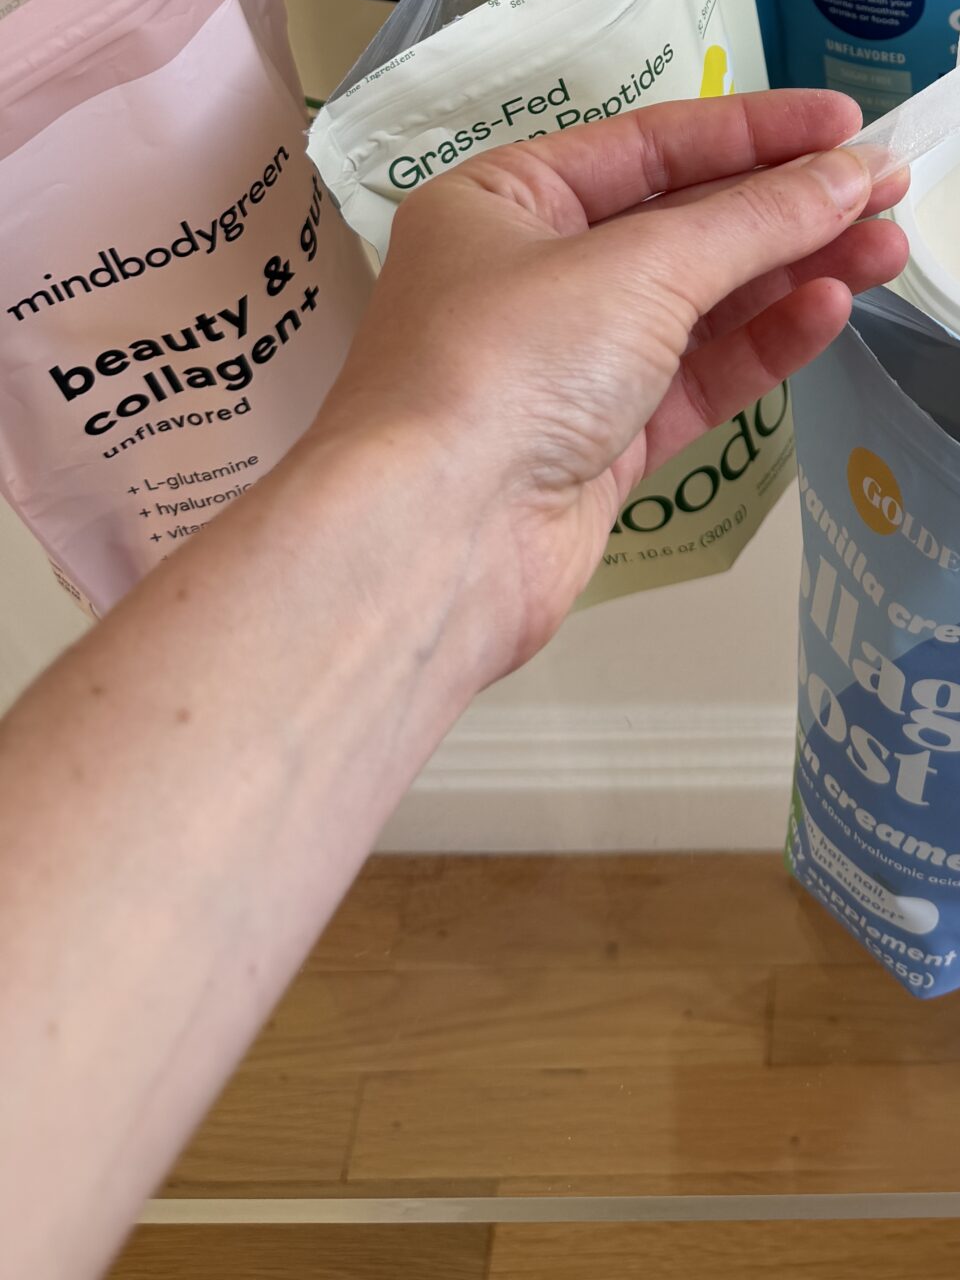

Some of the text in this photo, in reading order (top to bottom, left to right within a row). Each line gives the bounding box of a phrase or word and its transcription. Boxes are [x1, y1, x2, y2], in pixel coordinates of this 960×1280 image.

[345, 50, 417, 98] One Ingredient
[826, 39, 907, 64] UNFLAVORED
[555, 42, 675, 130] Peptides
[388, 77, 571, 190] Grass-Fed
[6, 145, 290, 322] mindbodygreen
[48, 174, 323, 402] beauty & gut
[84, 284, 320, 436] collagen+
[102, 397, 252, 459] unflavored
[609, 379, 789, 535] oodo
[144, 454, 260, 492] L-glutamine
[156, 482, 253, 517] hyaluronic
[603, 504, 748, 566] WT. 10.6 oz (300 g)
[812, 847, 834, 869] int
[818, 832, 850, 871] hair,
[853, 869, 887, 902] nail,
[853, 830, 924, 880] hyaluronic
[807, 867, 958, 968] supplement
